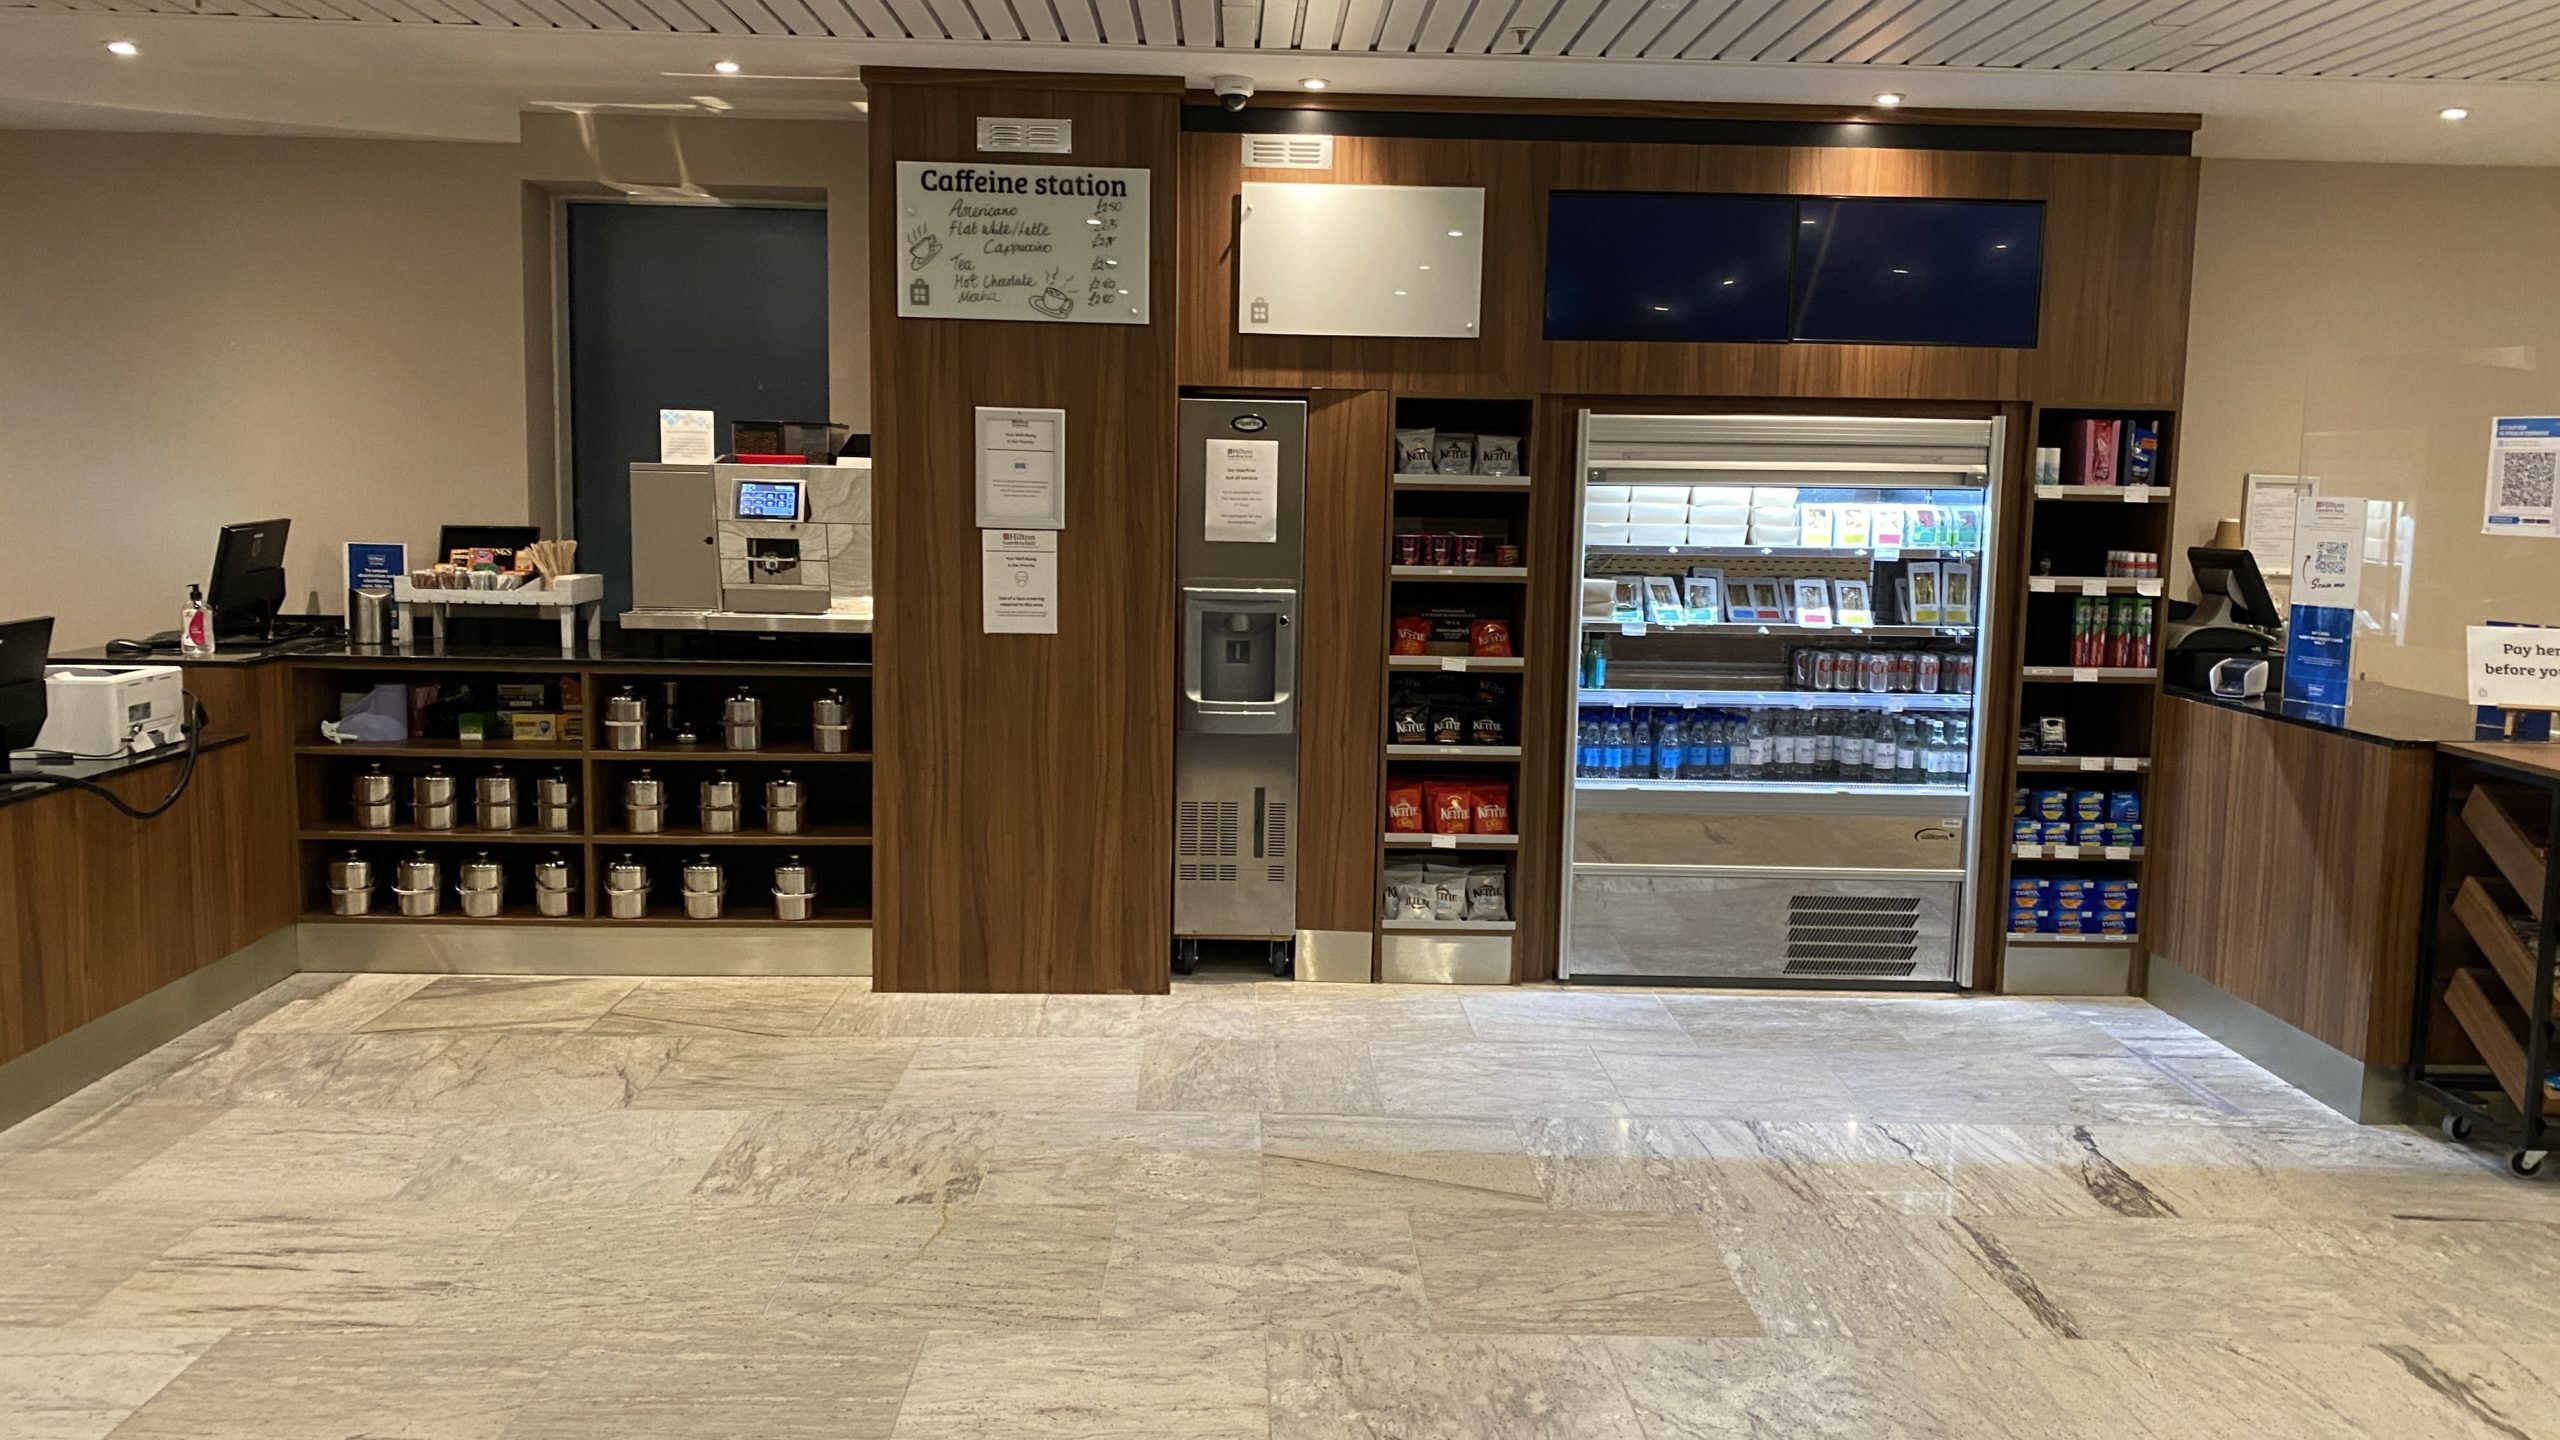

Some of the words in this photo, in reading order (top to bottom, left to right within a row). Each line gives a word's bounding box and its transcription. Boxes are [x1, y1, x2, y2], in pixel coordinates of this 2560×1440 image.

[921, 169, 1028, 194] Caffeine
[1034, 173, 1127, 197] station
[949, 198, 1018, 217] Americano
[949, 220, 978, 236] Flat
[949, 253, 975, 271] Tea
[954, 273, 979, 289] Hot
[2311, 578, 2331, 590] Scan
[2503, 643, 2532, 659] Pay
[2536, 644, 2560, 656] her
[2484, 663, 2536, 676] before
[2539, 667, 2560, 680] yo
